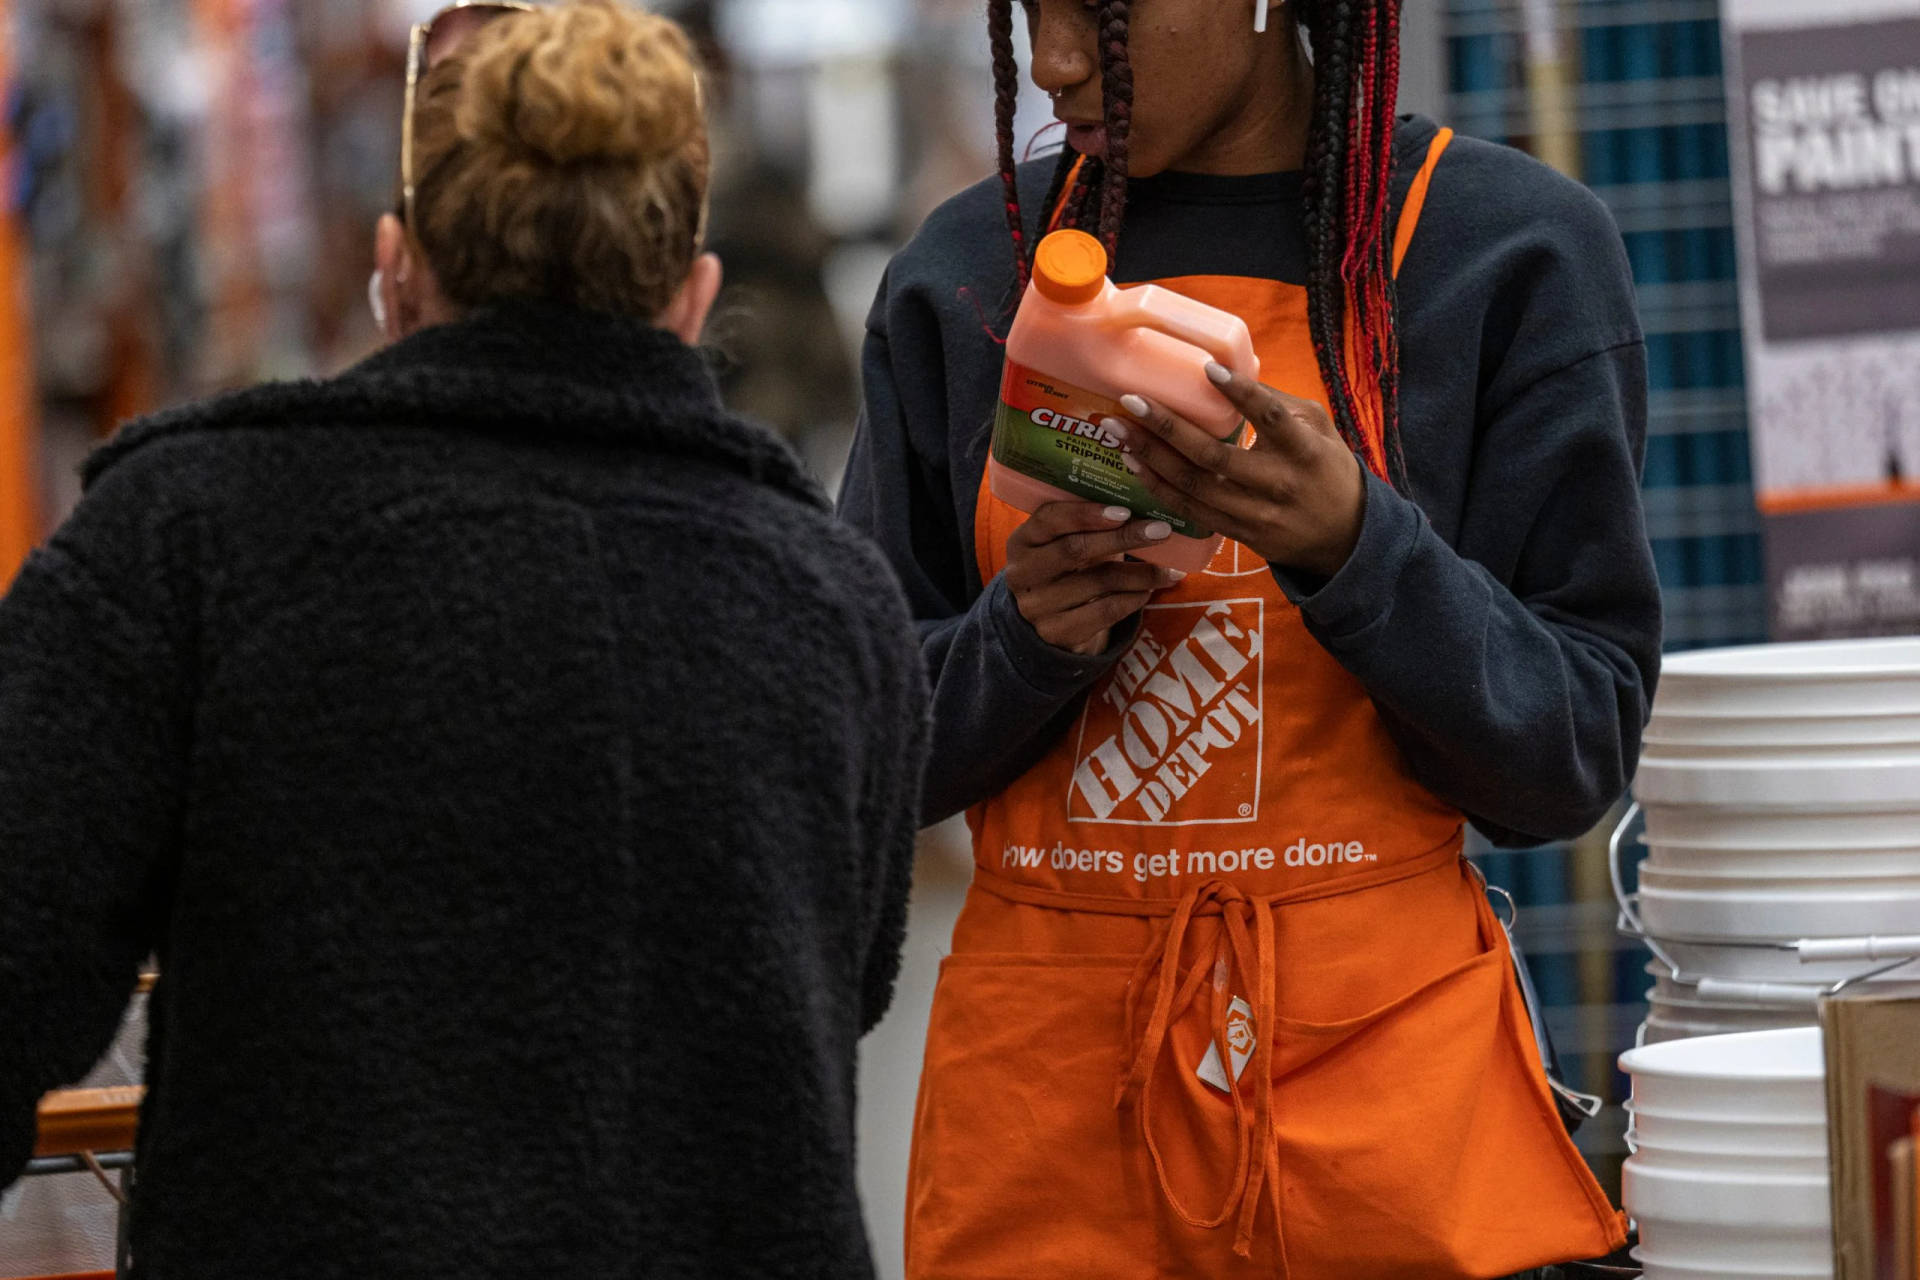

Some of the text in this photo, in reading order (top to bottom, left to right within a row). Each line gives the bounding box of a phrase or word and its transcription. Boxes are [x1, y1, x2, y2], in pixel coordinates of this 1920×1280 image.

[1753, 75, 1867, 122] SAVE
[1030, 407, 1132, 454] CITRIS
[1055, 439, 1124, 472] STRIPPING
[1103, 450, 1124, 462] VAR
[1102, 628, 1168, 717] THE
[1075, 602, 1261, 820] HOME
[1136, 682, 1259, 822] DEPOT
[1050, 841, 1124, 874] doers
[1133, 848, 1181, 882] get
[1186, 846, 1275, 874] more
